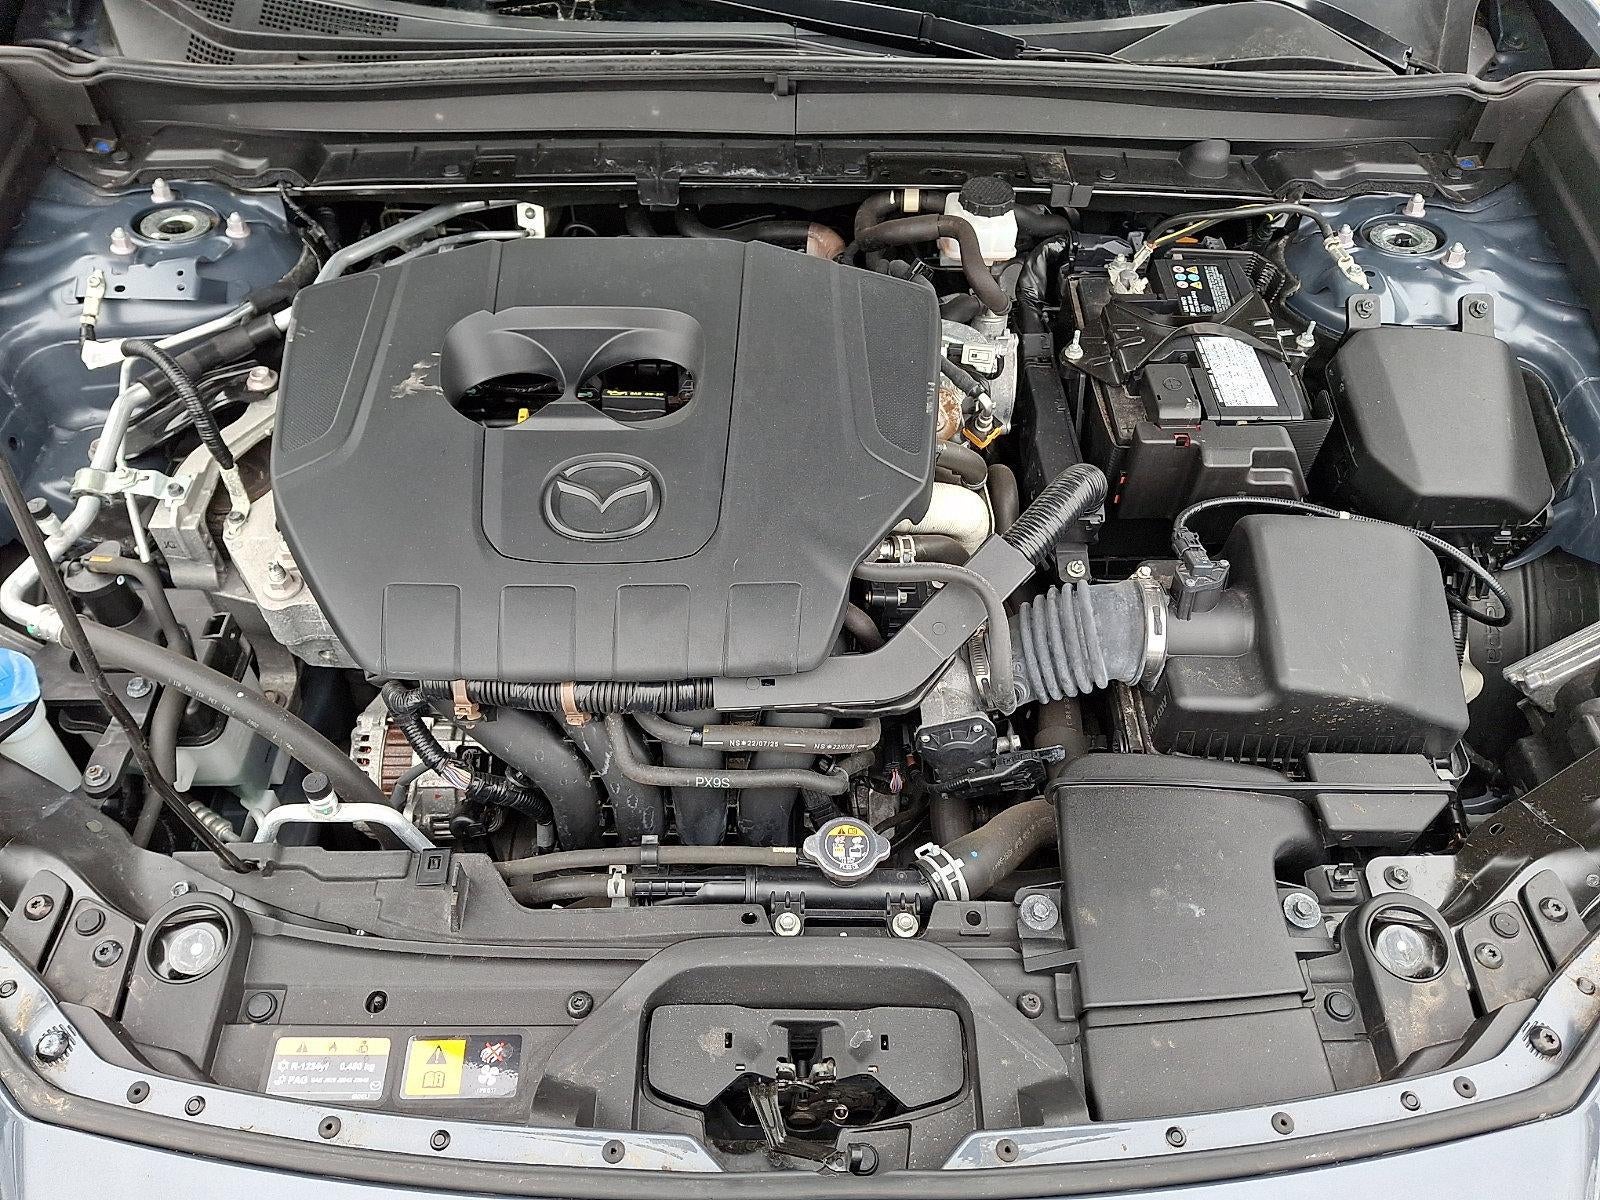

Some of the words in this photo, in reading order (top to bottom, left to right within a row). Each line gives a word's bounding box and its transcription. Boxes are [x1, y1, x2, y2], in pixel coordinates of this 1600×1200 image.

[729, 739, 741, 747] NS
[695, 776, 730, 788] PX9S
[287, 1075, 308, 1085] PAG
